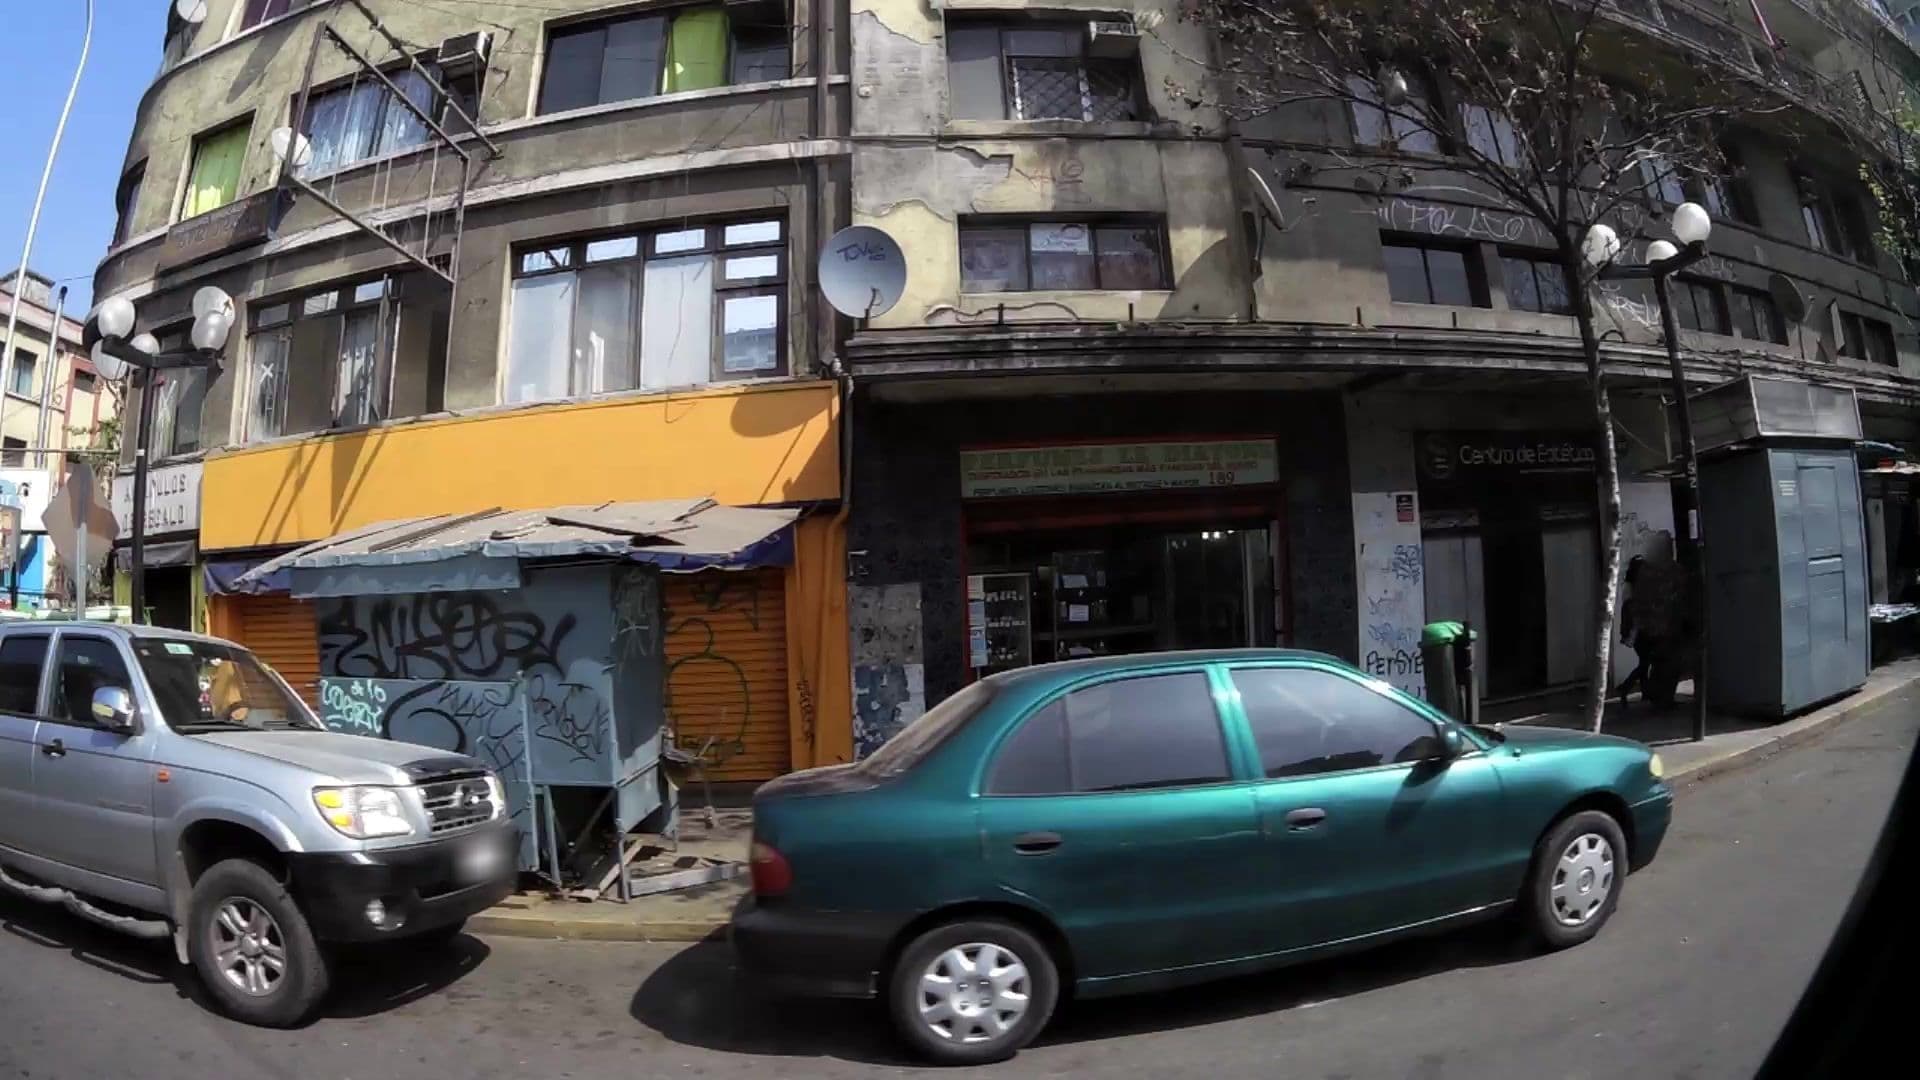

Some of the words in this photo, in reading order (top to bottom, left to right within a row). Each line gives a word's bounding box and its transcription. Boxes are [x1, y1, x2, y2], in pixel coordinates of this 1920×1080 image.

[1459, 444, 1514, 465] Centro
[1517, 444, 1536, 464] de
[1209, 471, 1235, 485] 189
